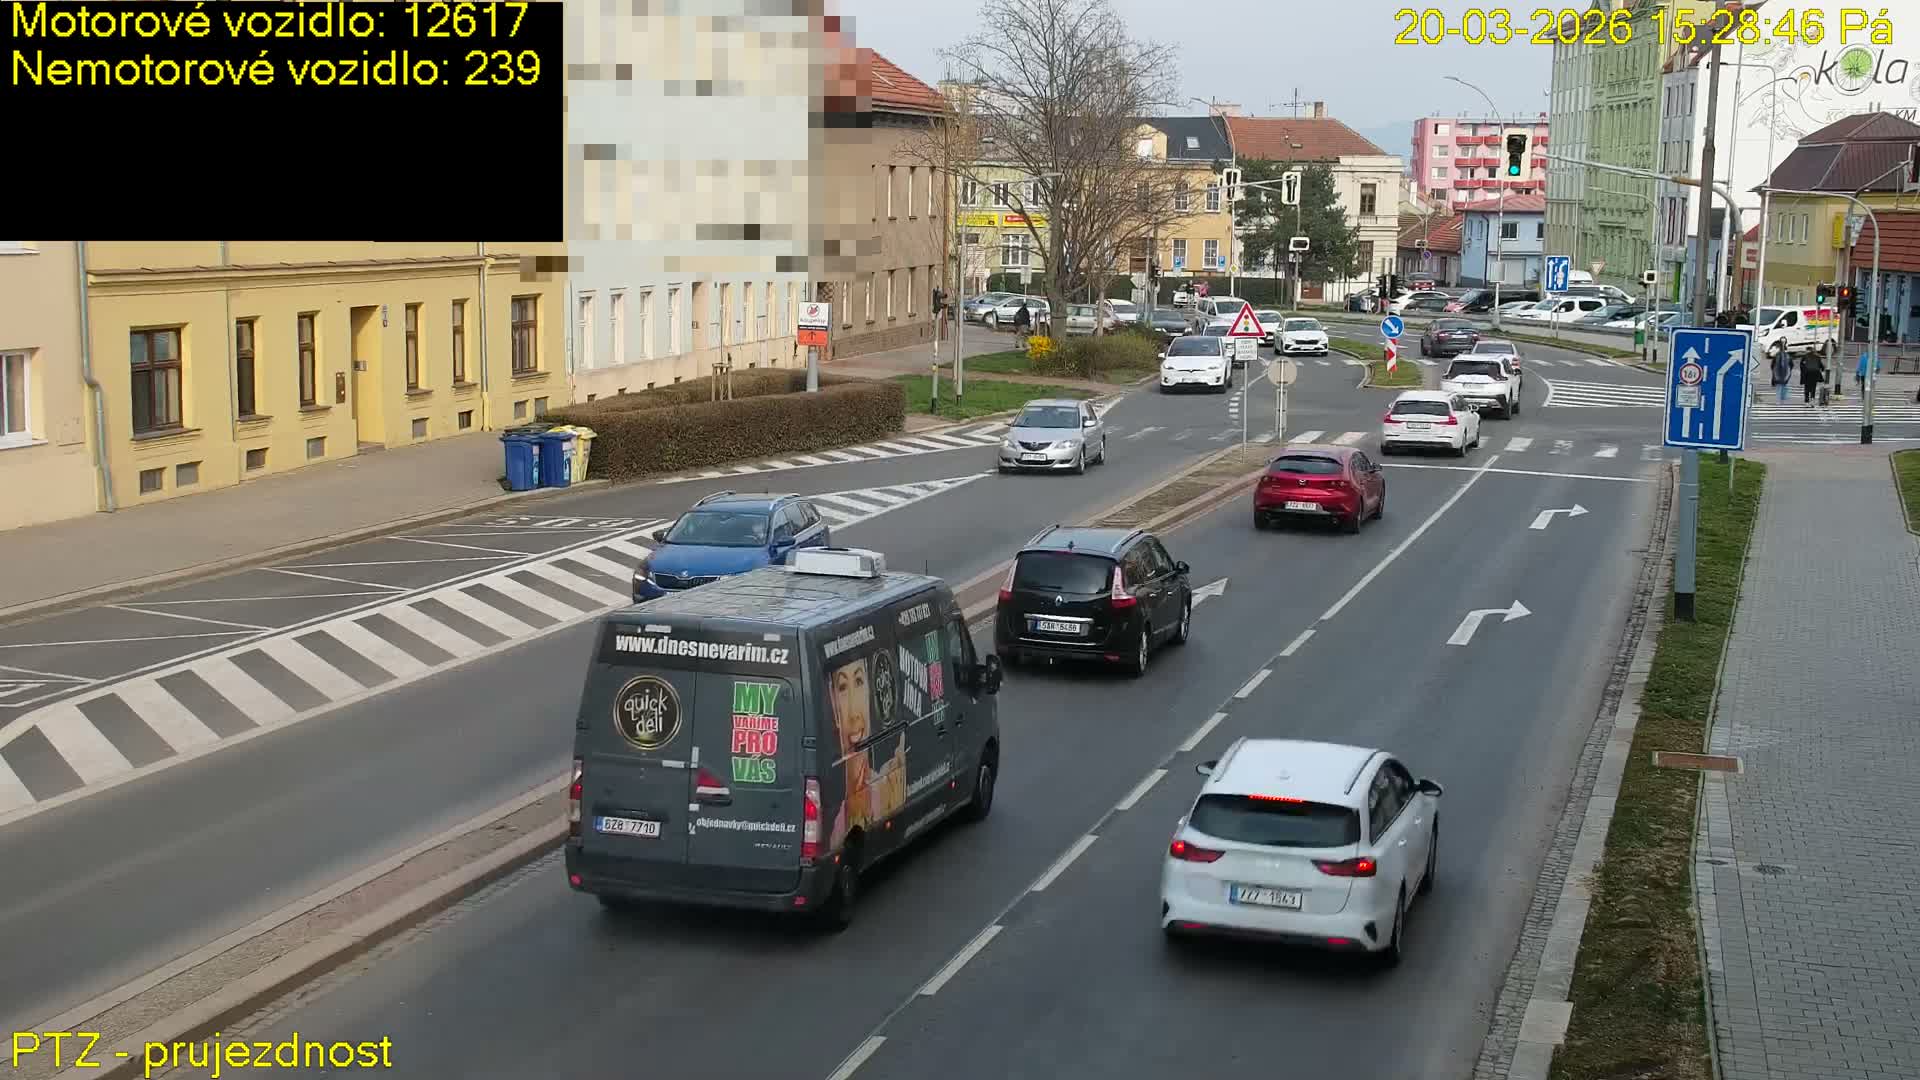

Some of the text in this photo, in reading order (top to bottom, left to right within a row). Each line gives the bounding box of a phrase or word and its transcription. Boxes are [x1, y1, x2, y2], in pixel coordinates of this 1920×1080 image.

[616, 634, 788, 665] www.dnesnevarim.cz
[624, 687, 668, 721] quick
[732, 681, 781, 715] MY
[636, 706, 663, 735] deli
[731, 729, 778, 756] PRO
[731, 755, 777, 784] VÁS
[631, 821, 656, 834] 7710
